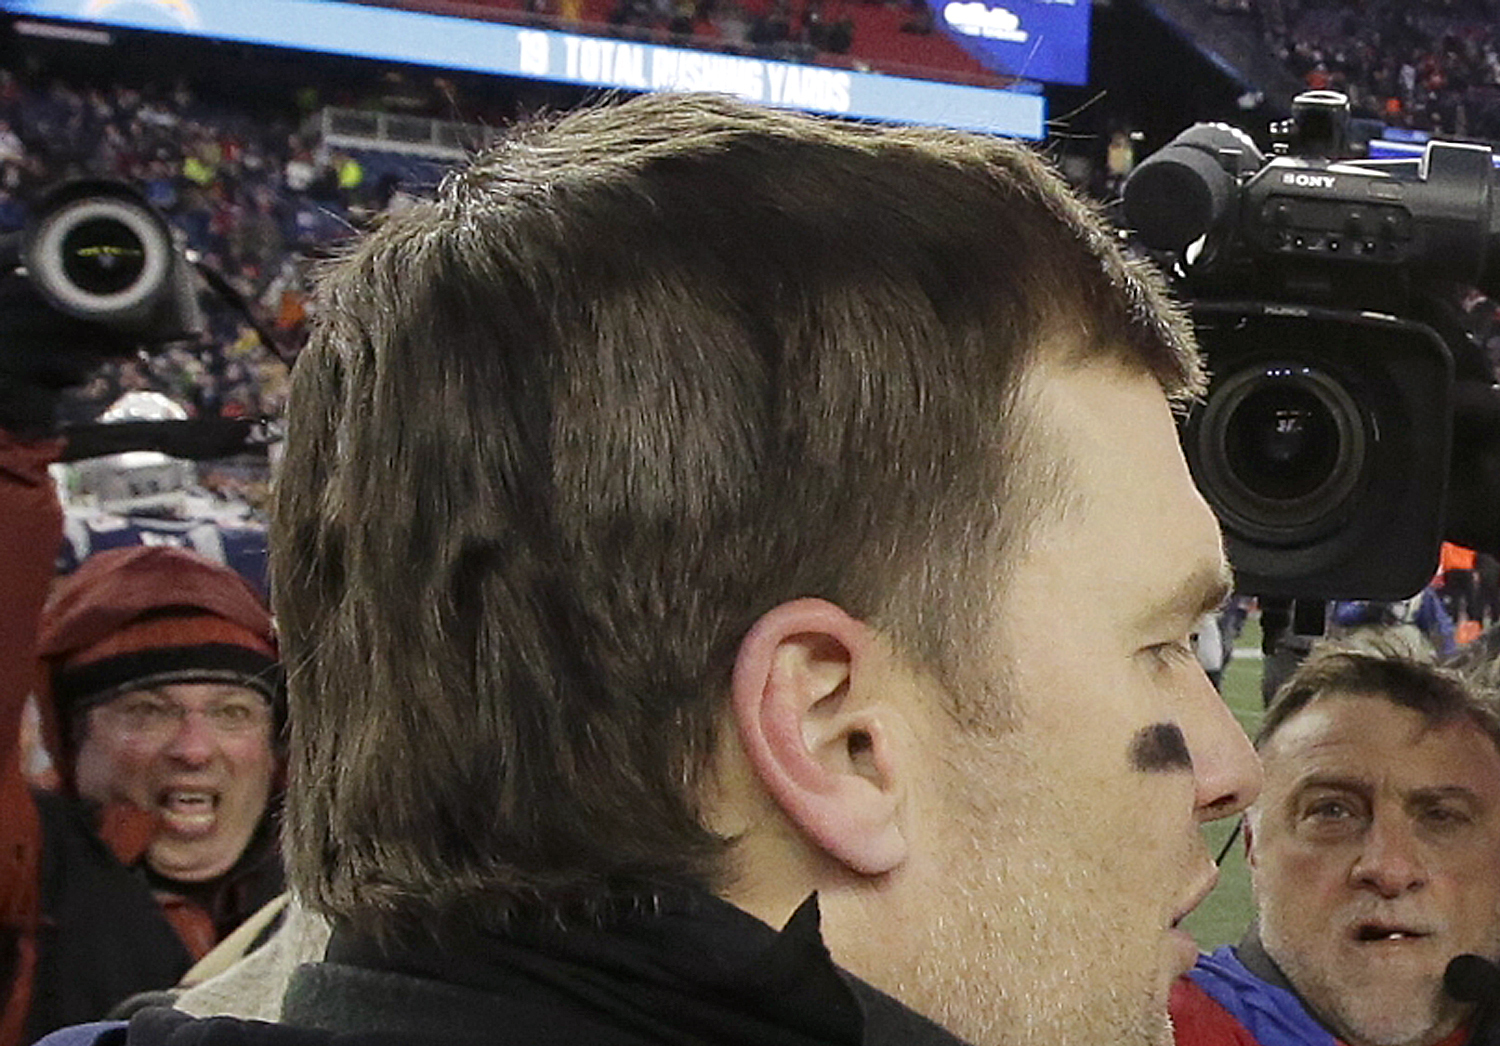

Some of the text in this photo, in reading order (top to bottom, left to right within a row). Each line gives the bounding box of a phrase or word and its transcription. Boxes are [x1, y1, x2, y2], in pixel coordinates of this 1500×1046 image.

[517, 31, 549, 75] 19
[565, 36, 646, 88] TOTAL
[767, 62, 851, 113] YARDS
[1282, 173, 1336, 188] SONY
